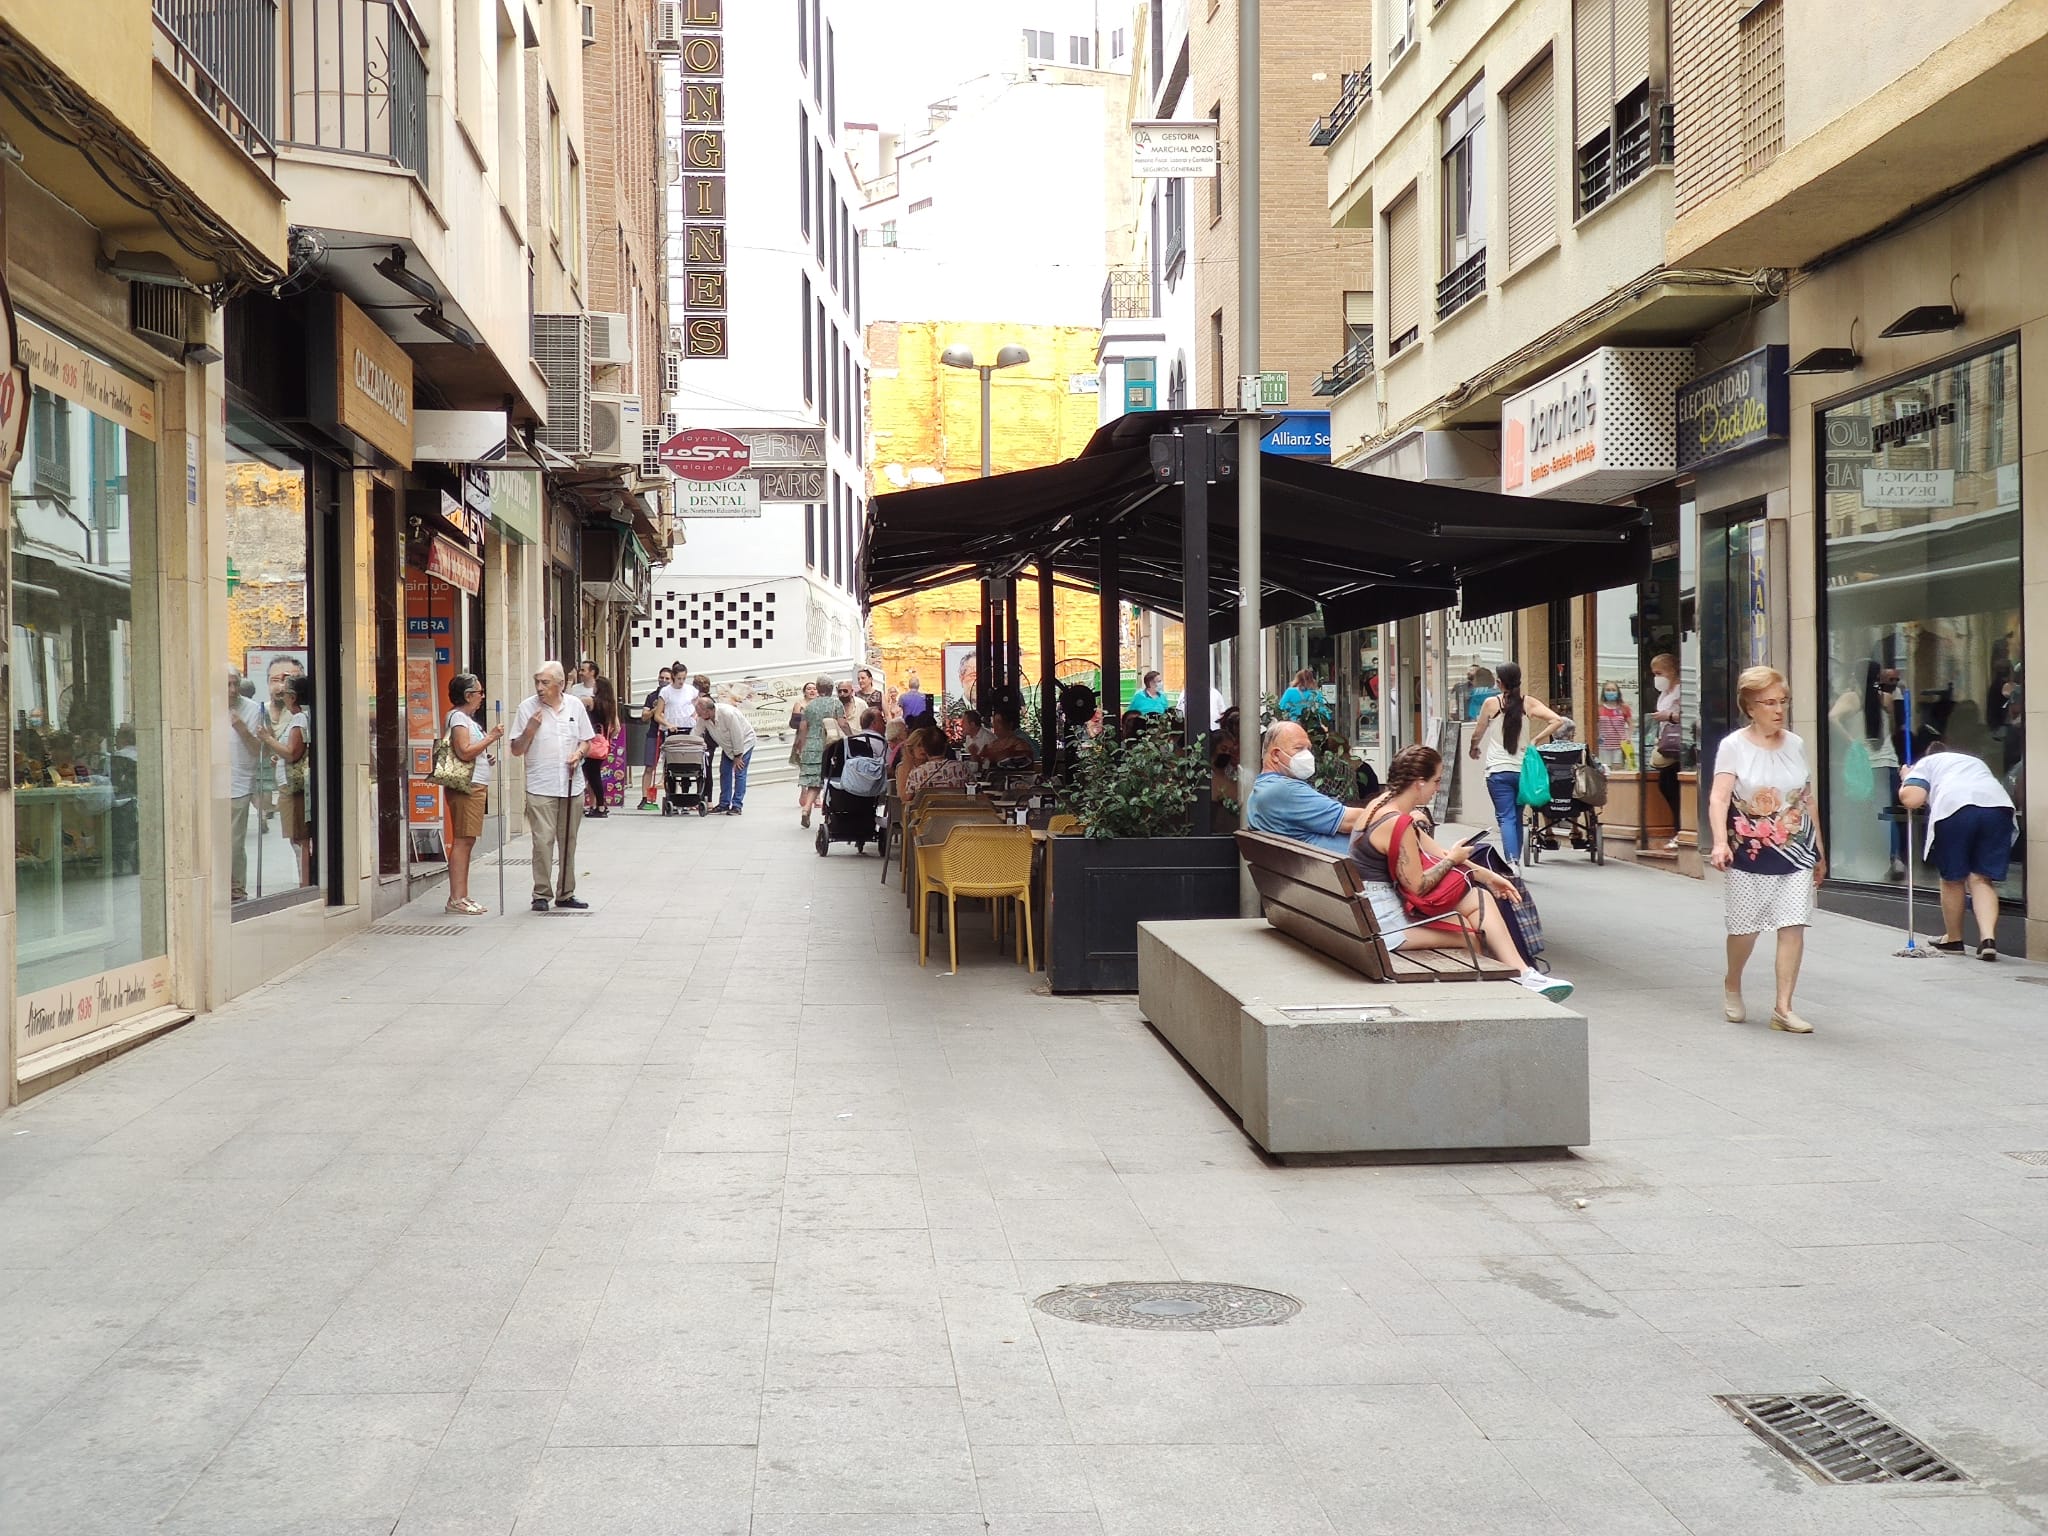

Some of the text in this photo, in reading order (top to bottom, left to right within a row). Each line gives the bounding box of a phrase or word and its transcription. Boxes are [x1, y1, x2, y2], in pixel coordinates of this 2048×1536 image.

[1161, 133, 1199, 141] GESTORIA
[1190, 145, 1214, 153] POZO
[686, 0, 723, 354] LONGINES
[355, 347, 394, 416] CALZADOS
[1679, 369, 1750, 424] ELECTRICIDAD
[1530, 369, 1597, 453] barchafe
[1695, 396, 1768, 453] Padilla
[750, 434, 820, 458] ERIA
[1271, 431, 1331, 447] Allianz Se
[660, 445, 748, 462] JOSAN
[690, 496, 746, 506] DENTAL
[1754, 555, 1767, 666] PADI
[410, 620, 446, 631] FIBRA
